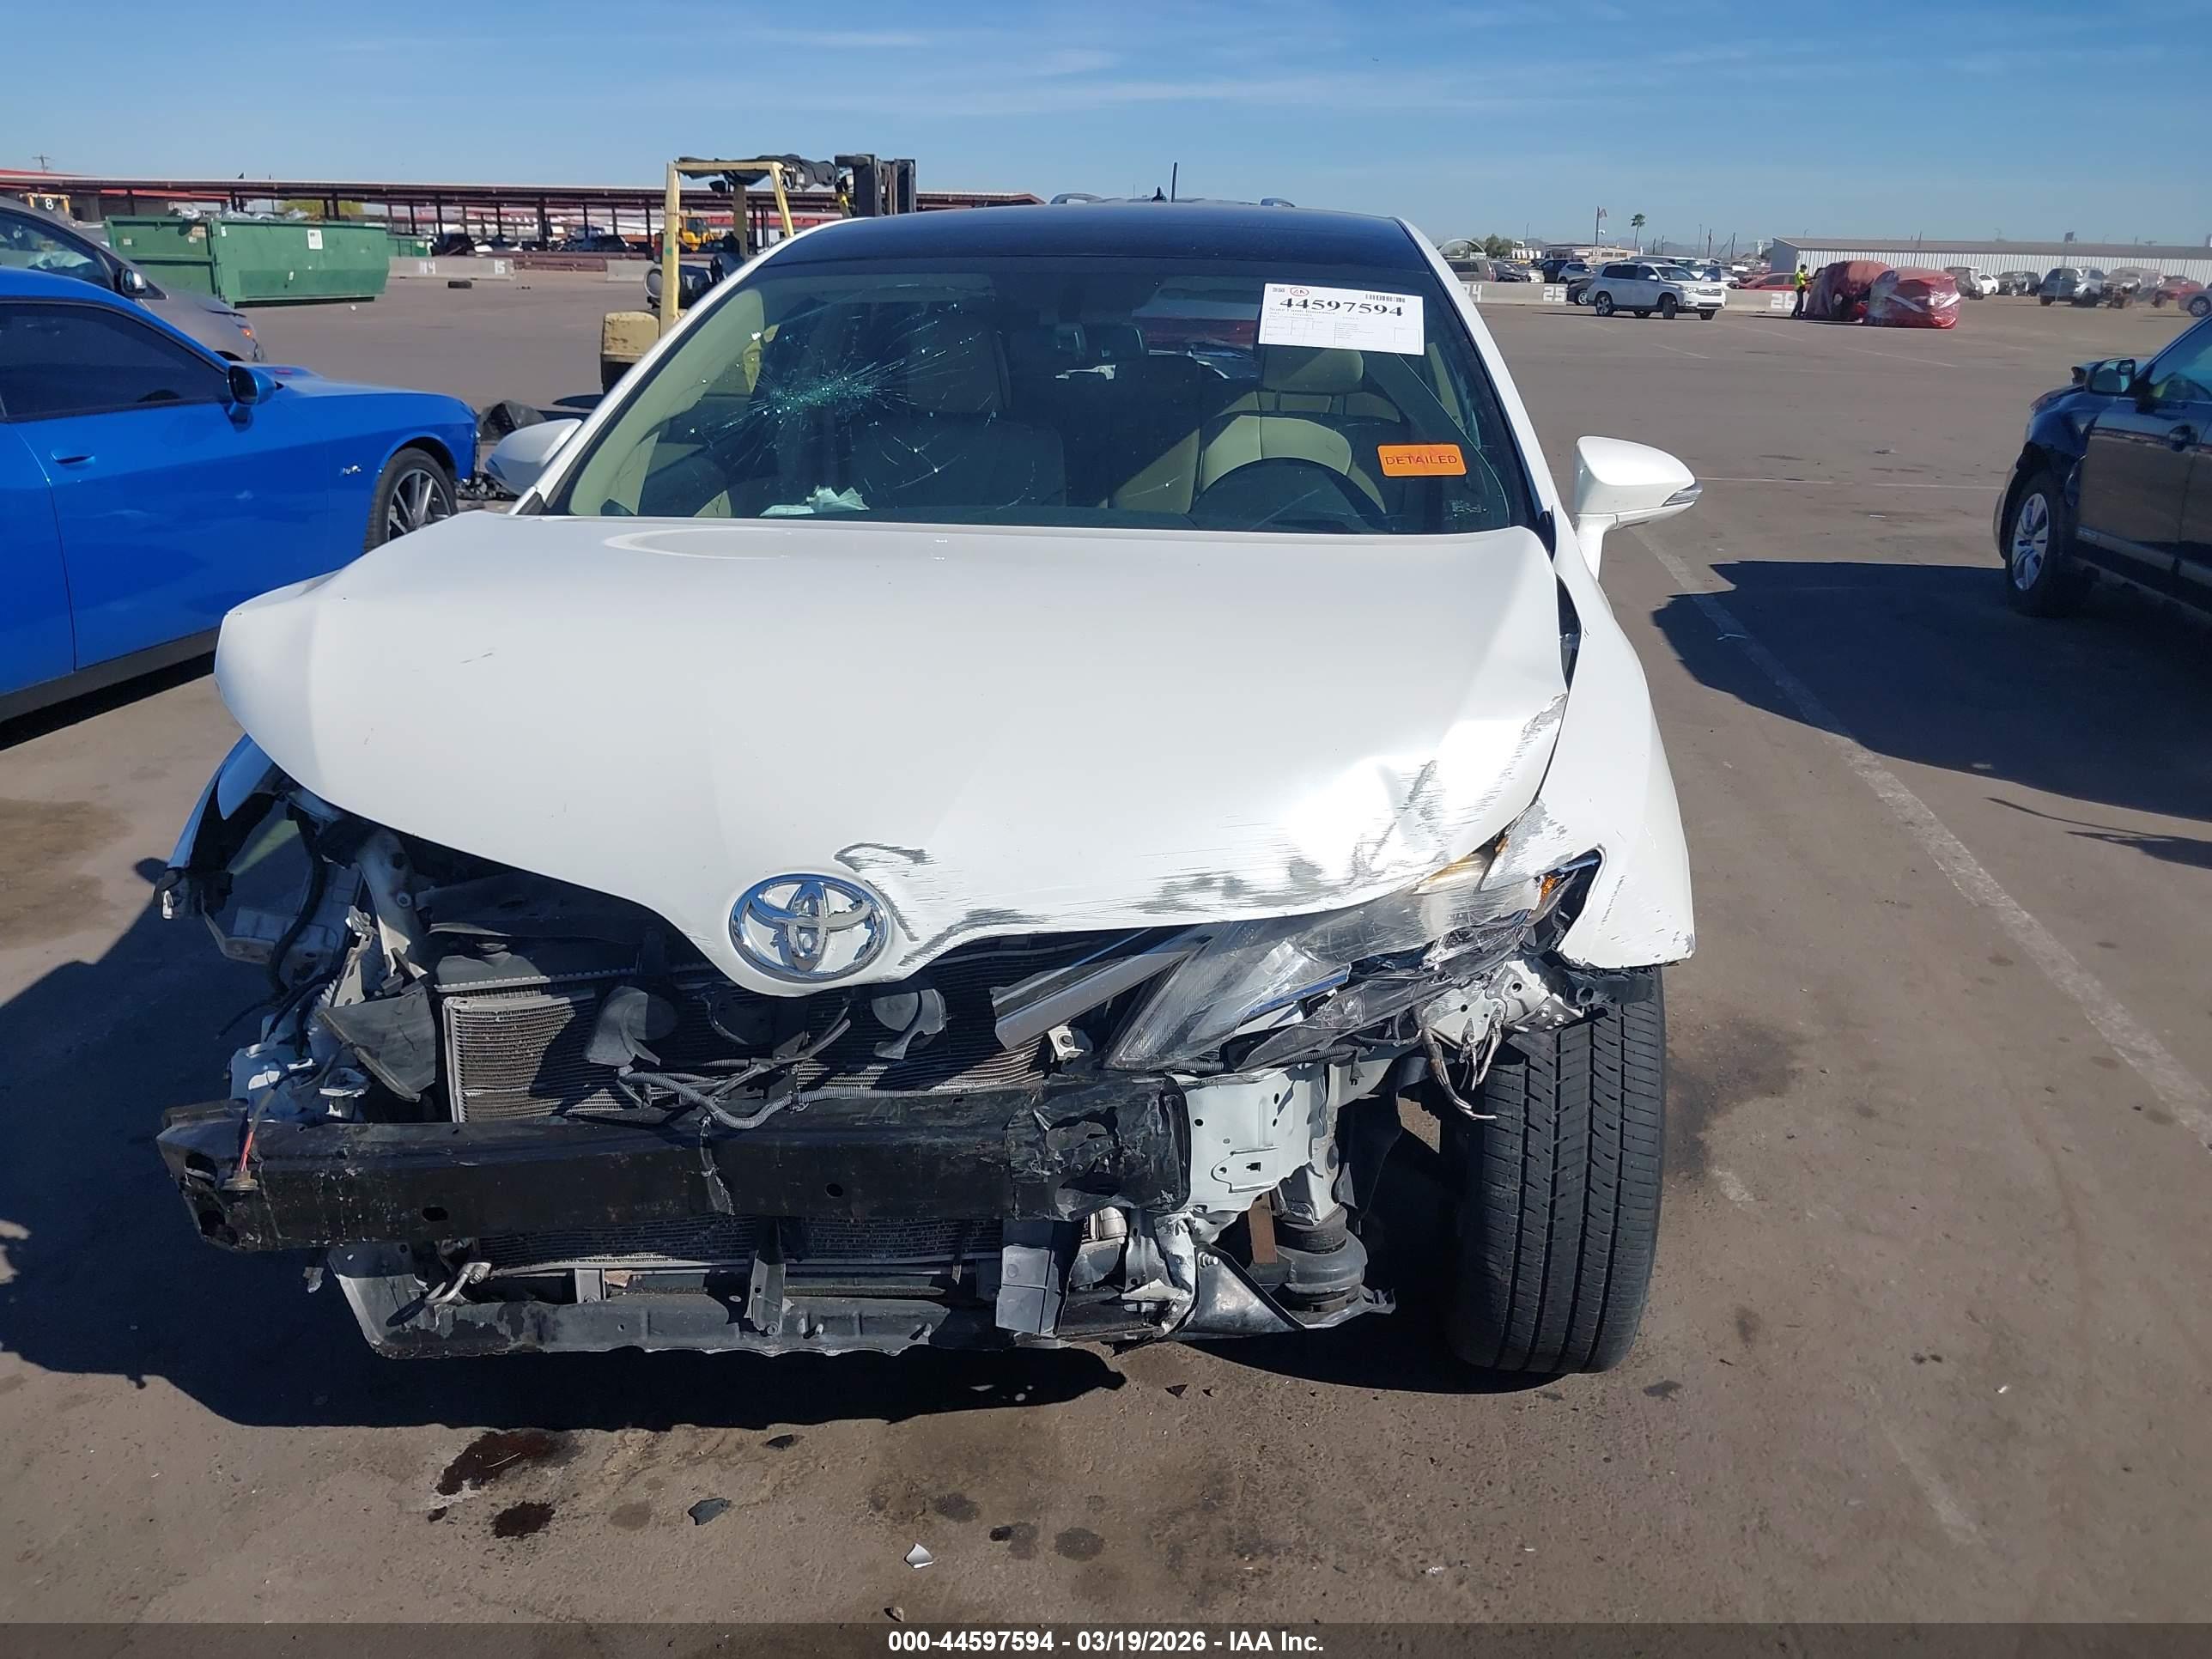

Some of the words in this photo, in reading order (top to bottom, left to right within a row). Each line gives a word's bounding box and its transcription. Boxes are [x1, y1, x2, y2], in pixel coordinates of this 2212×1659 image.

[45, 198, 54, 210] 8
[1543, 286, 1566, 302] 25
[1771, 292, 1796, 309] 26
[1279, 297, 1404, 317] 44597594
[1385, 455, 1457, 465] DETAILED
